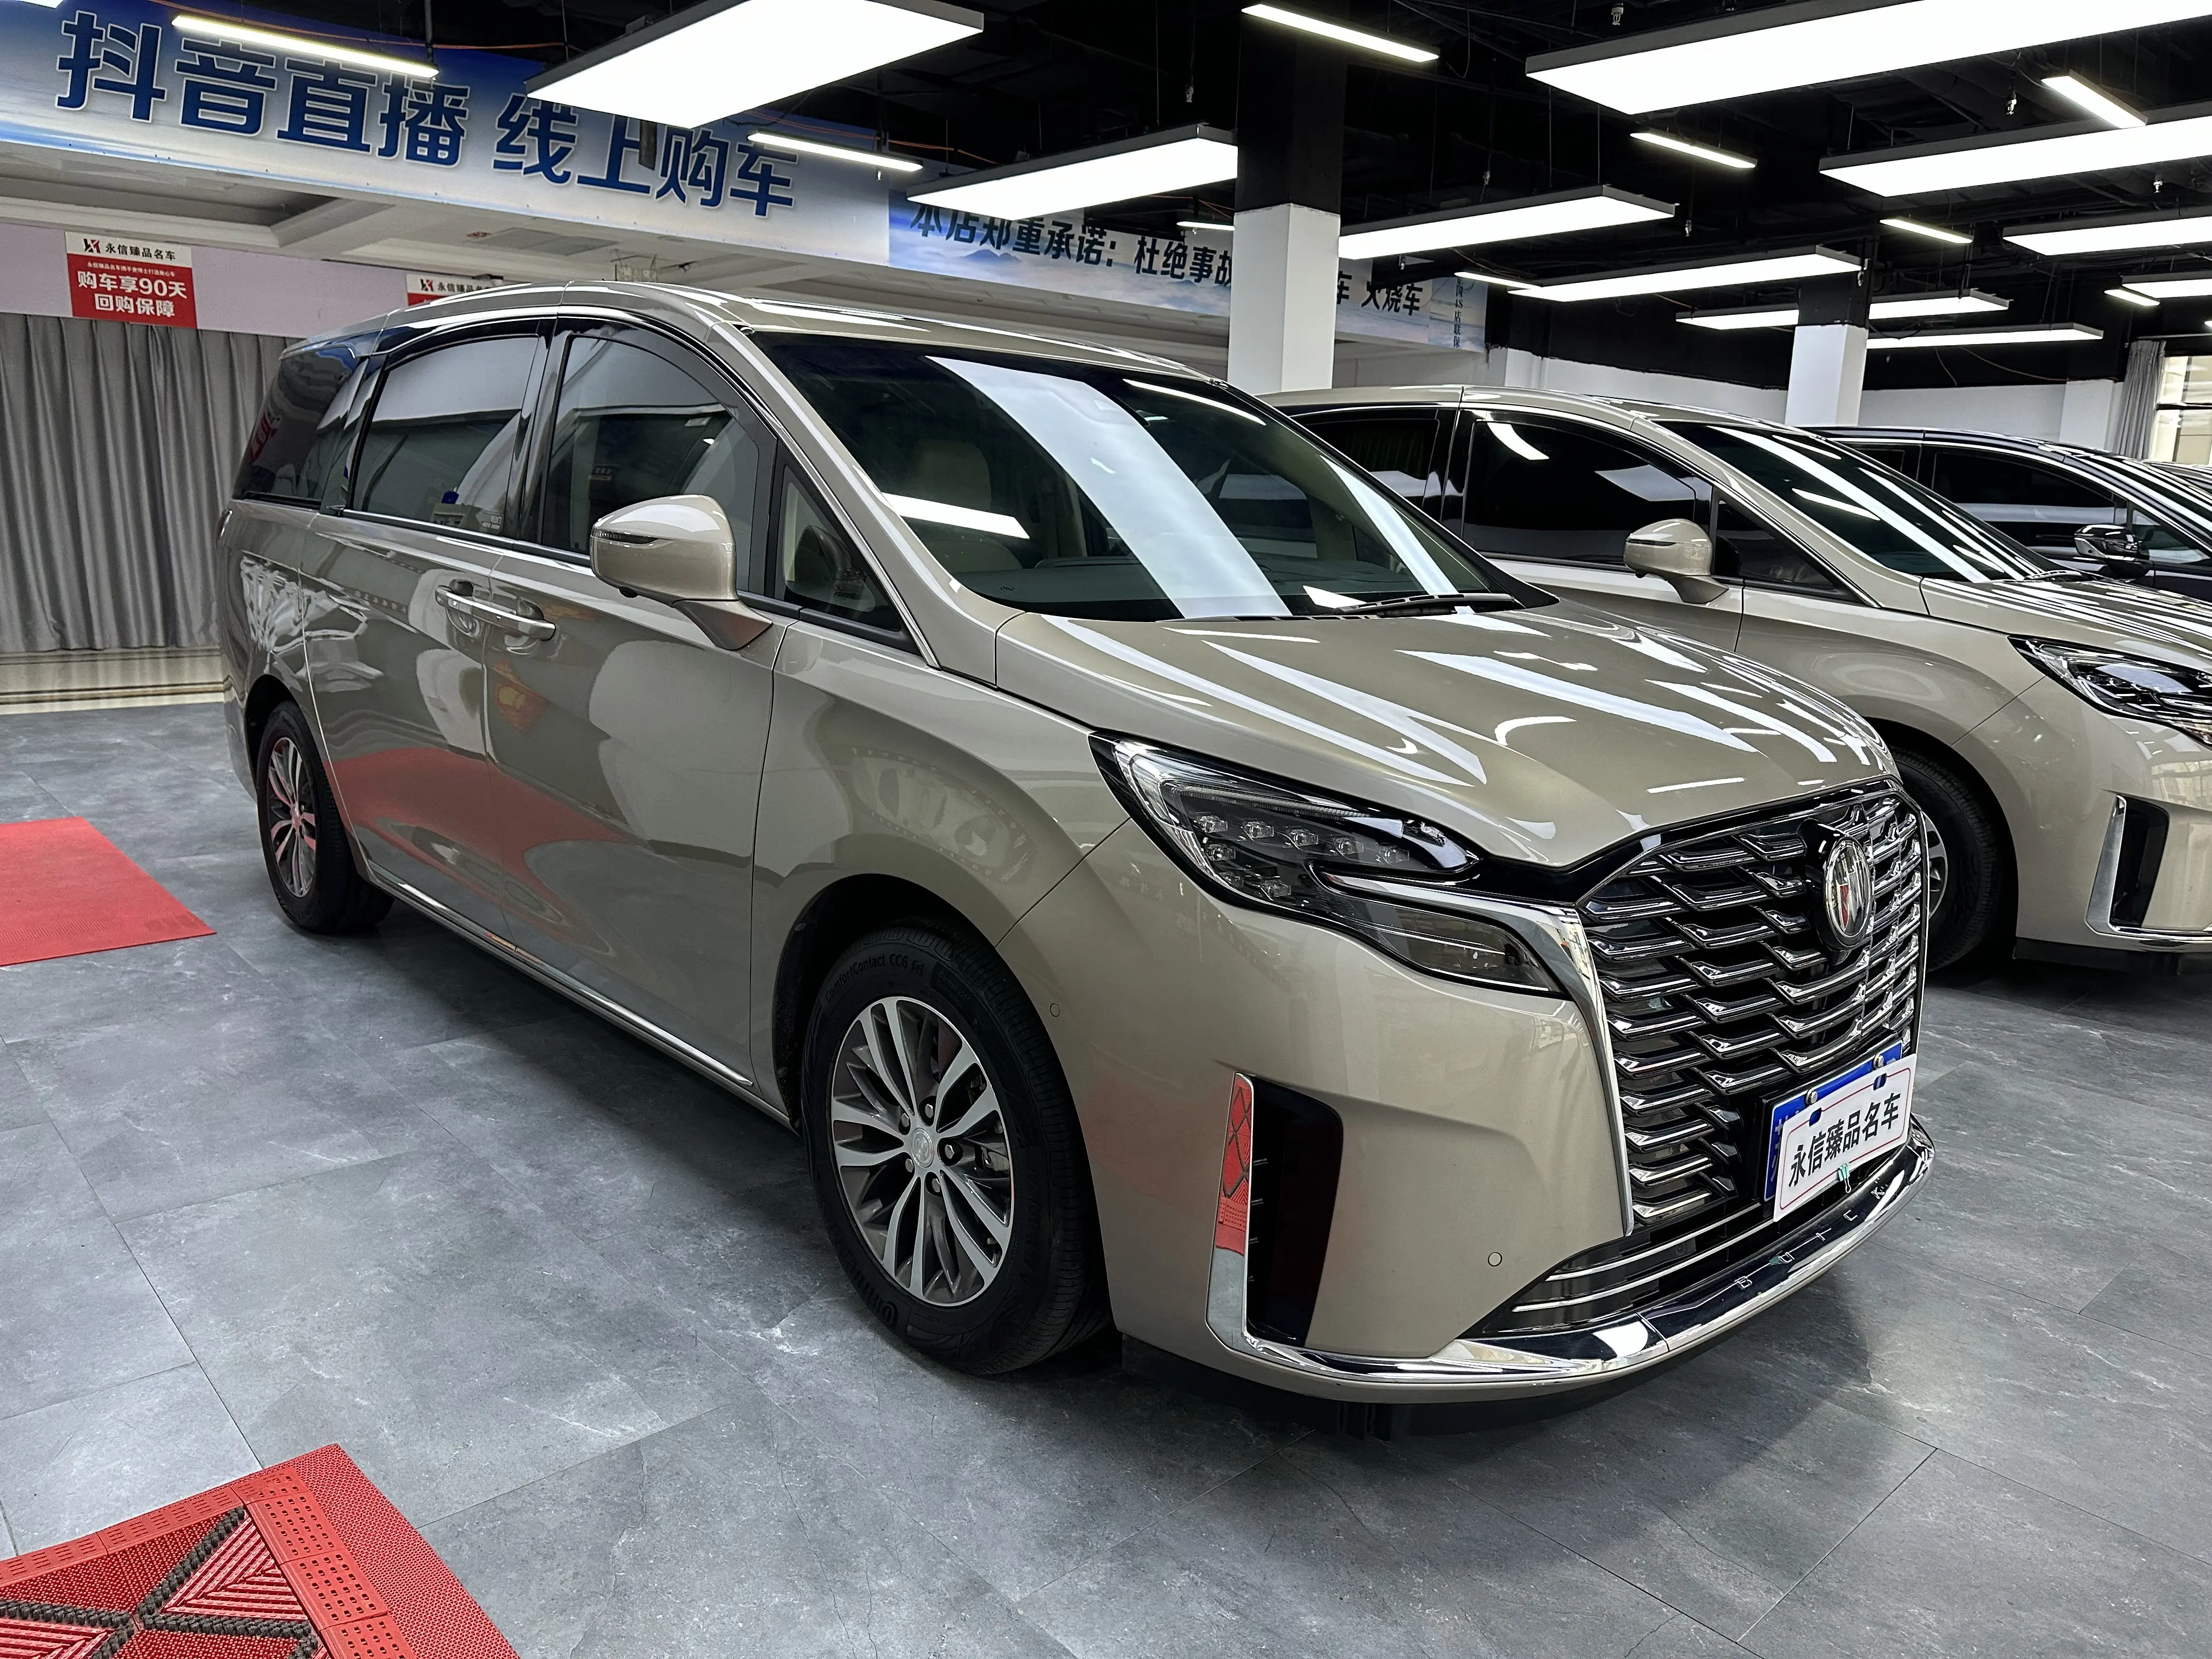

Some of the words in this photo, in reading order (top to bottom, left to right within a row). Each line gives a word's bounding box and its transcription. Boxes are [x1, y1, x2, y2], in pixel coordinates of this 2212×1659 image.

[56, 9, 472, 168] 抖音直播
[492, 93, 800, 219] 线上购车
[105, 242, 176, 261] 永信臻品名车
[77, 270, 188, 299] 购车享90天
[438, 281, 491, 293] 永信臻品
[94, 293, 176, 318] 回购保障
[825, 953, 886, 1003] ComfortContact
[889, 952, 909, 969] CC6
[1788, 1092, 1901, 1188] 永信臻品名车
